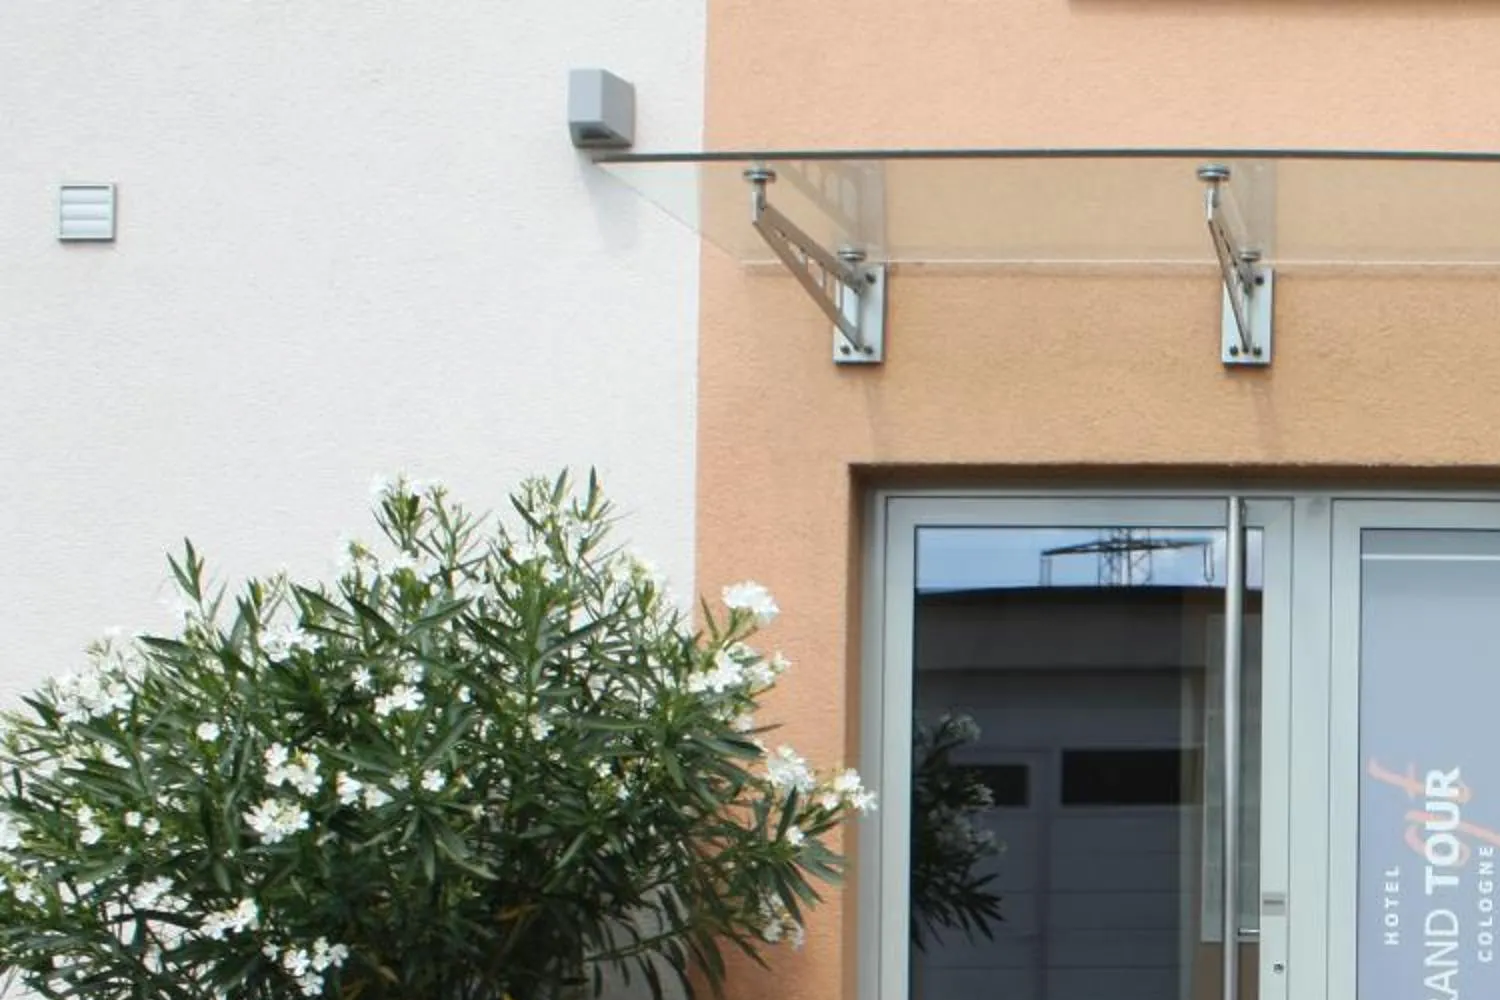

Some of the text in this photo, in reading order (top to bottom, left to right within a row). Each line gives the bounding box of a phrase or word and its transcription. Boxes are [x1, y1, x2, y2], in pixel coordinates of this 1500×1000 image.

[1424, 766, 1461, 895] TOUR
[1384, 865, 1400, 945] HOTEL
[1478, 846, 1494, 963] COLOGNE
